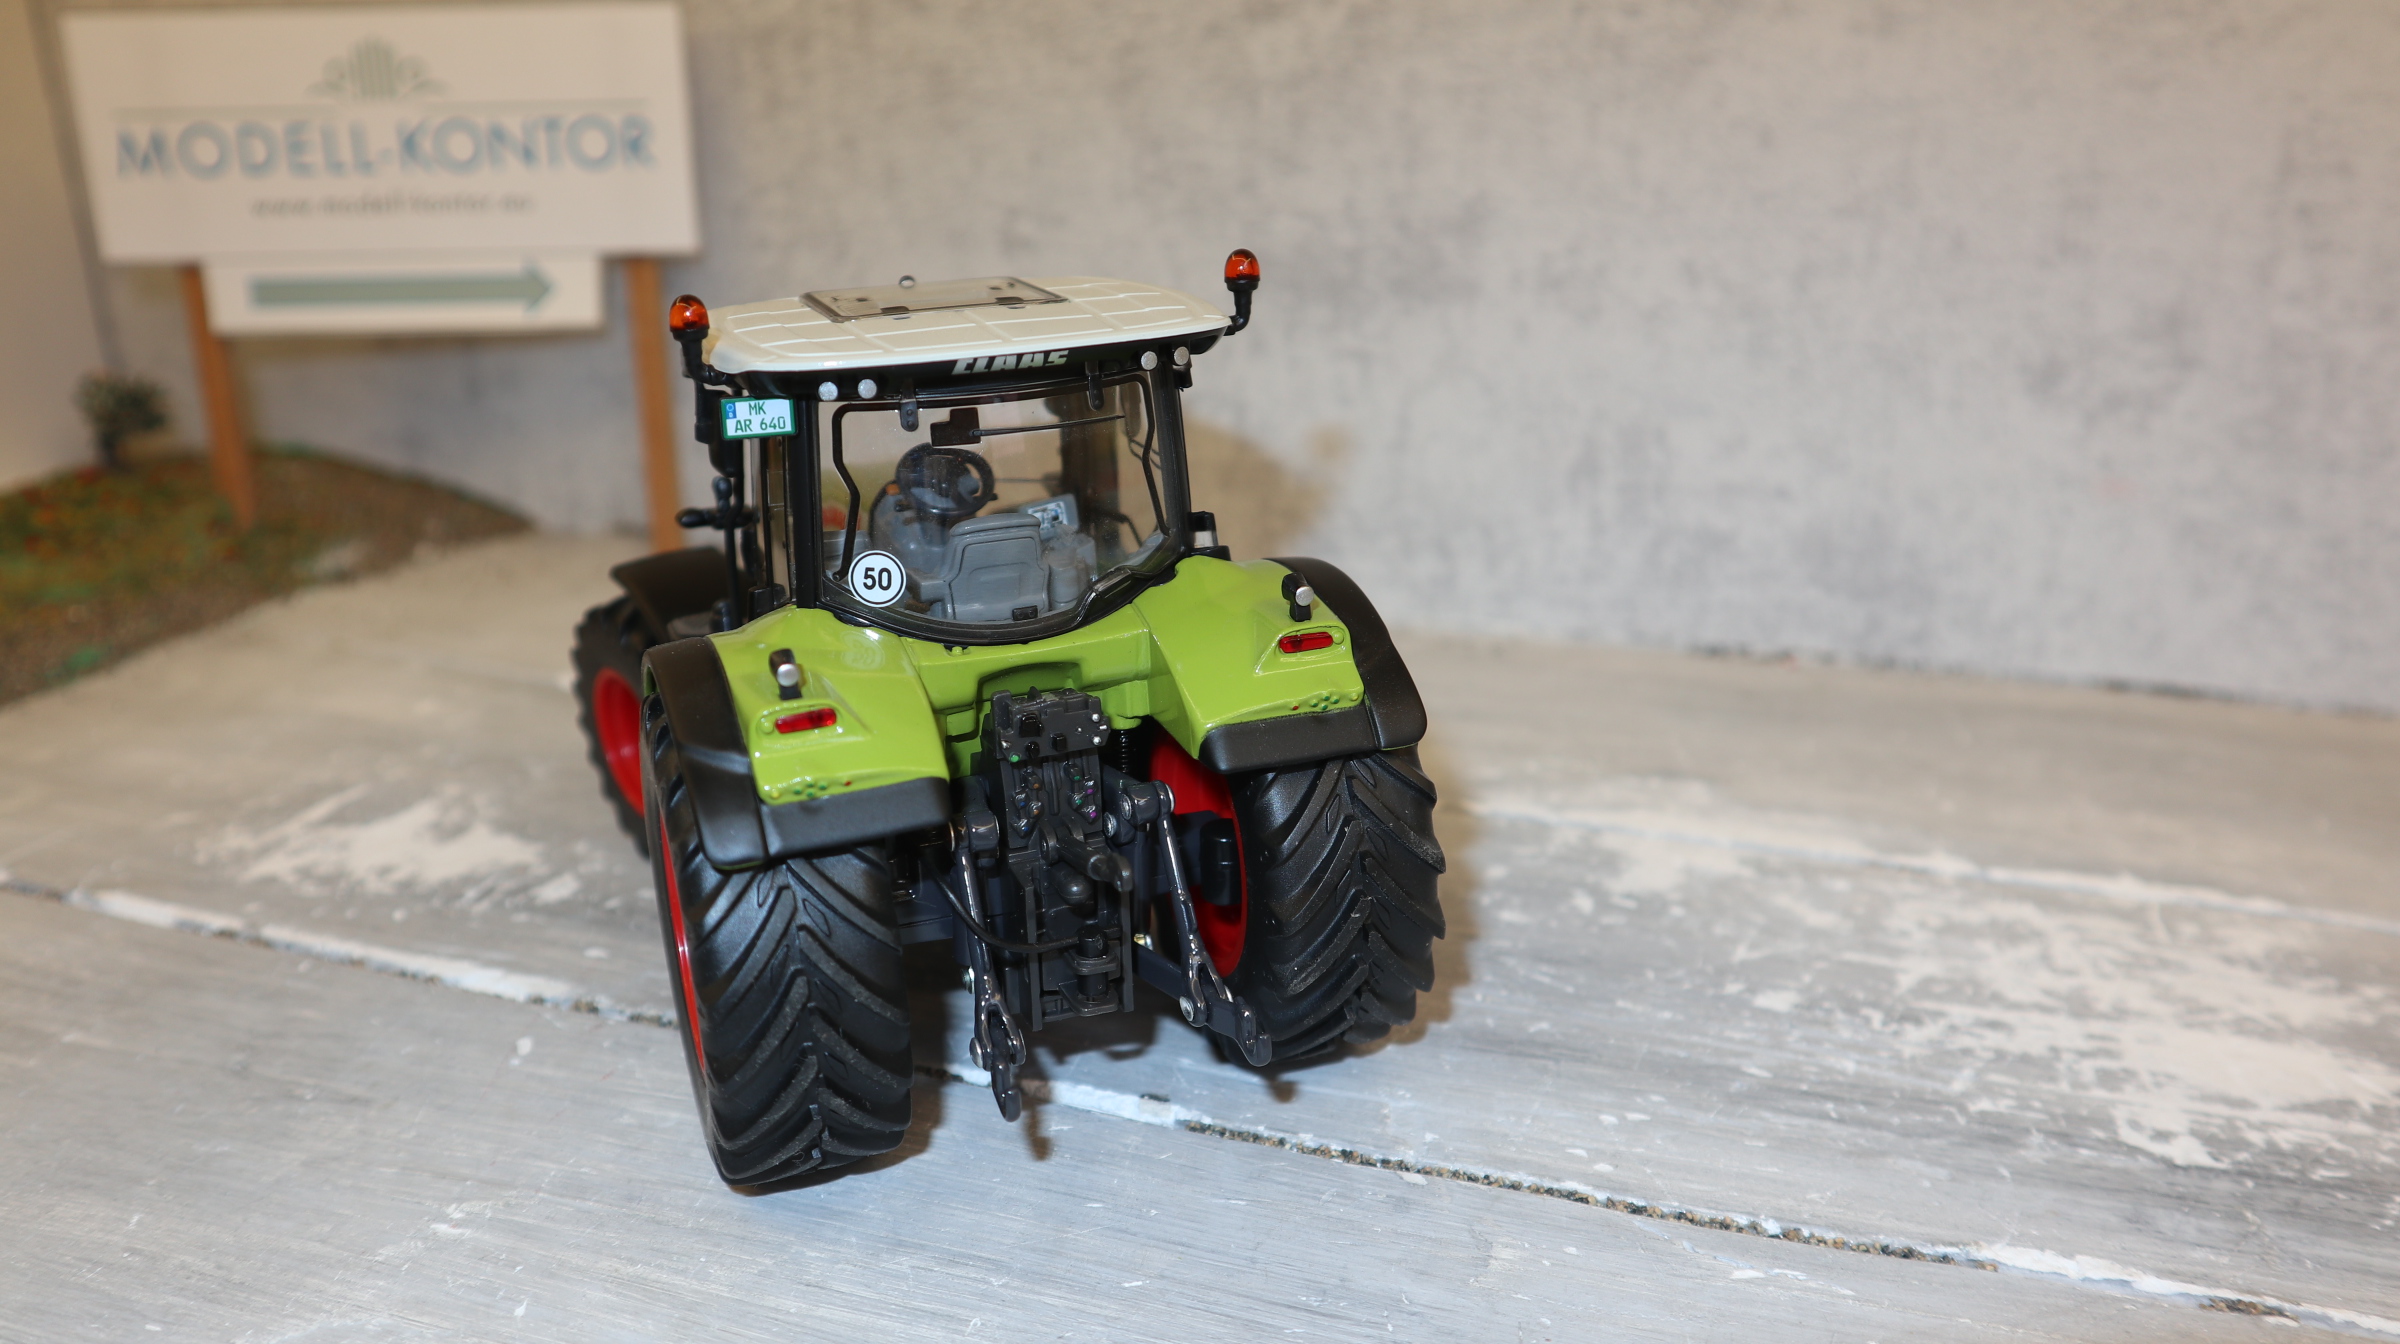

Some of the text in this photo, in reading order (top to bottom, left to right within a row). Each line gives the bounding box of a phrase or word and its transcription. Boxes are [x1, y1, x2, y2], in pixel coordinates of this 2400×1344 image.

[115, 114, 658, 181] MODELL-KONTOR
[951, 349, 1069, 375] CLAAS
[748, 401, 766, 416] MK
[734, 416, 786, 433] AR 640
[863, 567, 892, 591] 50
